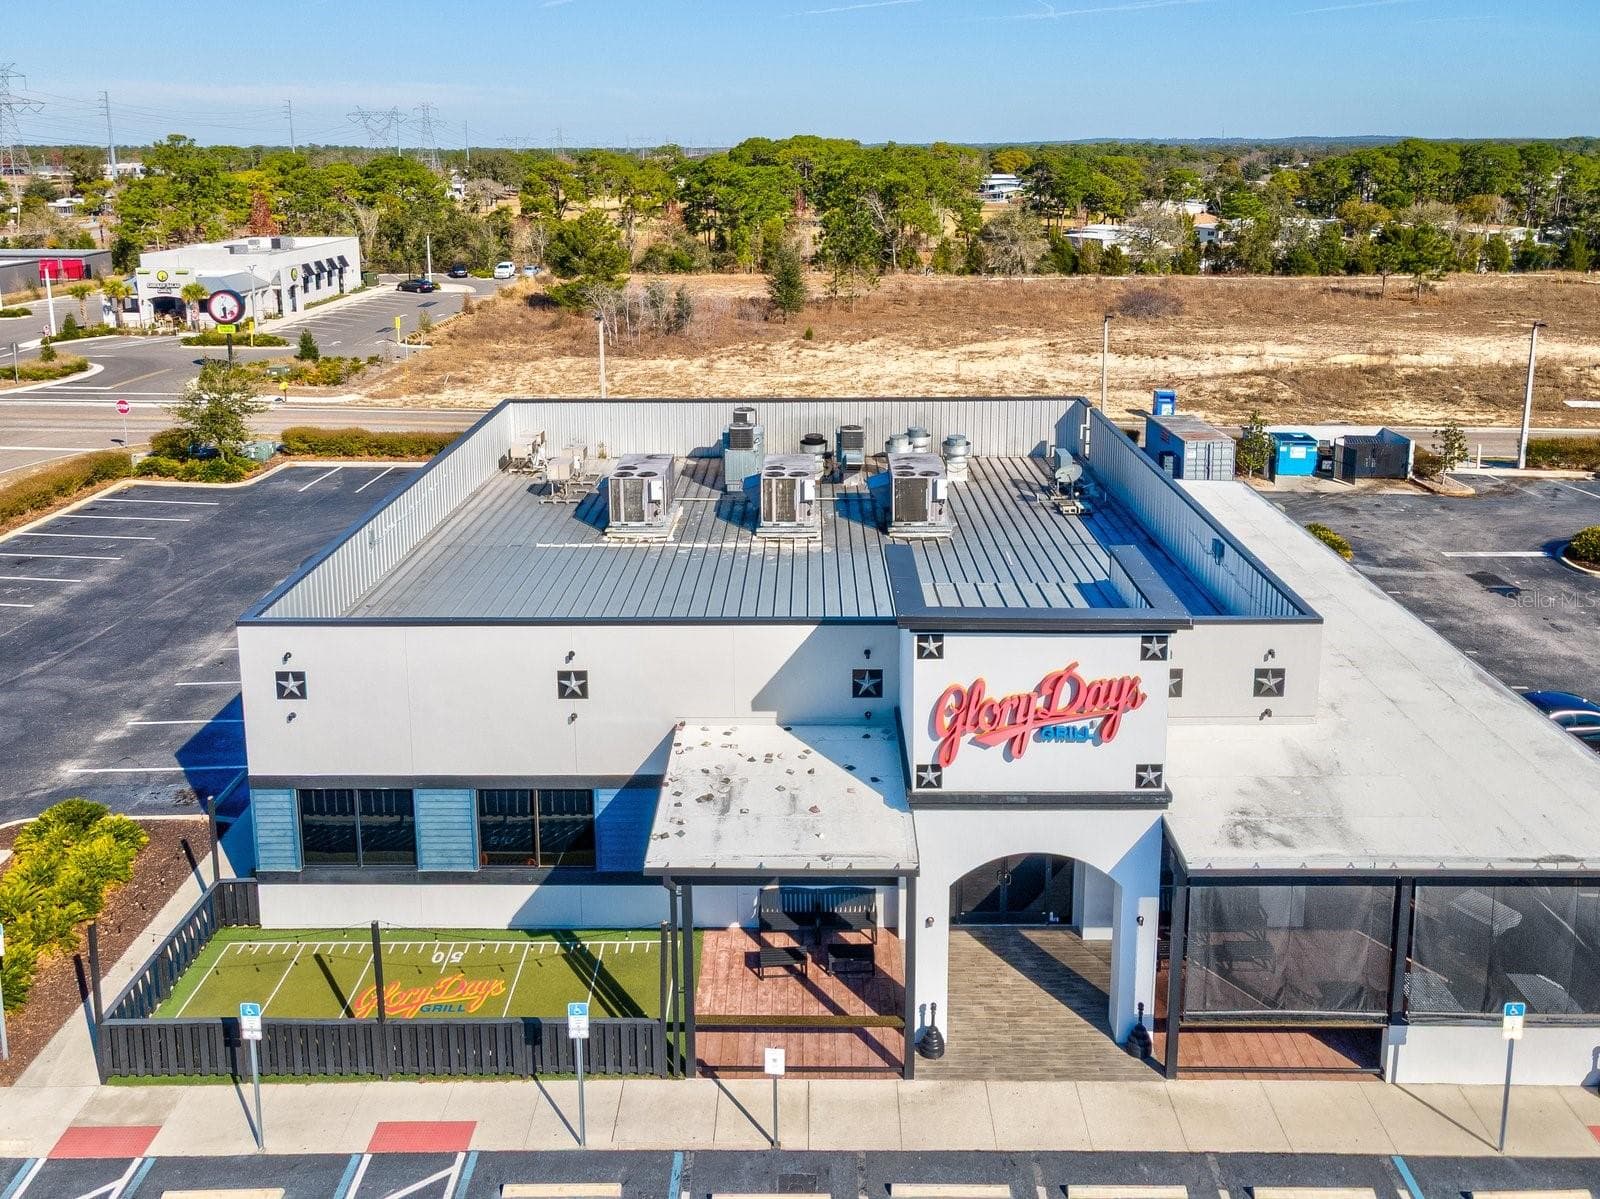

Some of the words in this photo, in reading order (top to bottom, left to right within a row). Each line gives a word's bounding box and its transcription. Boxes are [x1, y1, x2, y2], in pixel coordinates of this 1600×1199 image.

[935, 677, 1039, 768] Glory
[1038, 661, 1147, 743] Days
[1041, 725, 1095, 741] GRILL
[354, 981, 434, 1018] Glory
[434, 973, 506, 1013] Days
[420, 1004, 466, 1013] GRILL
